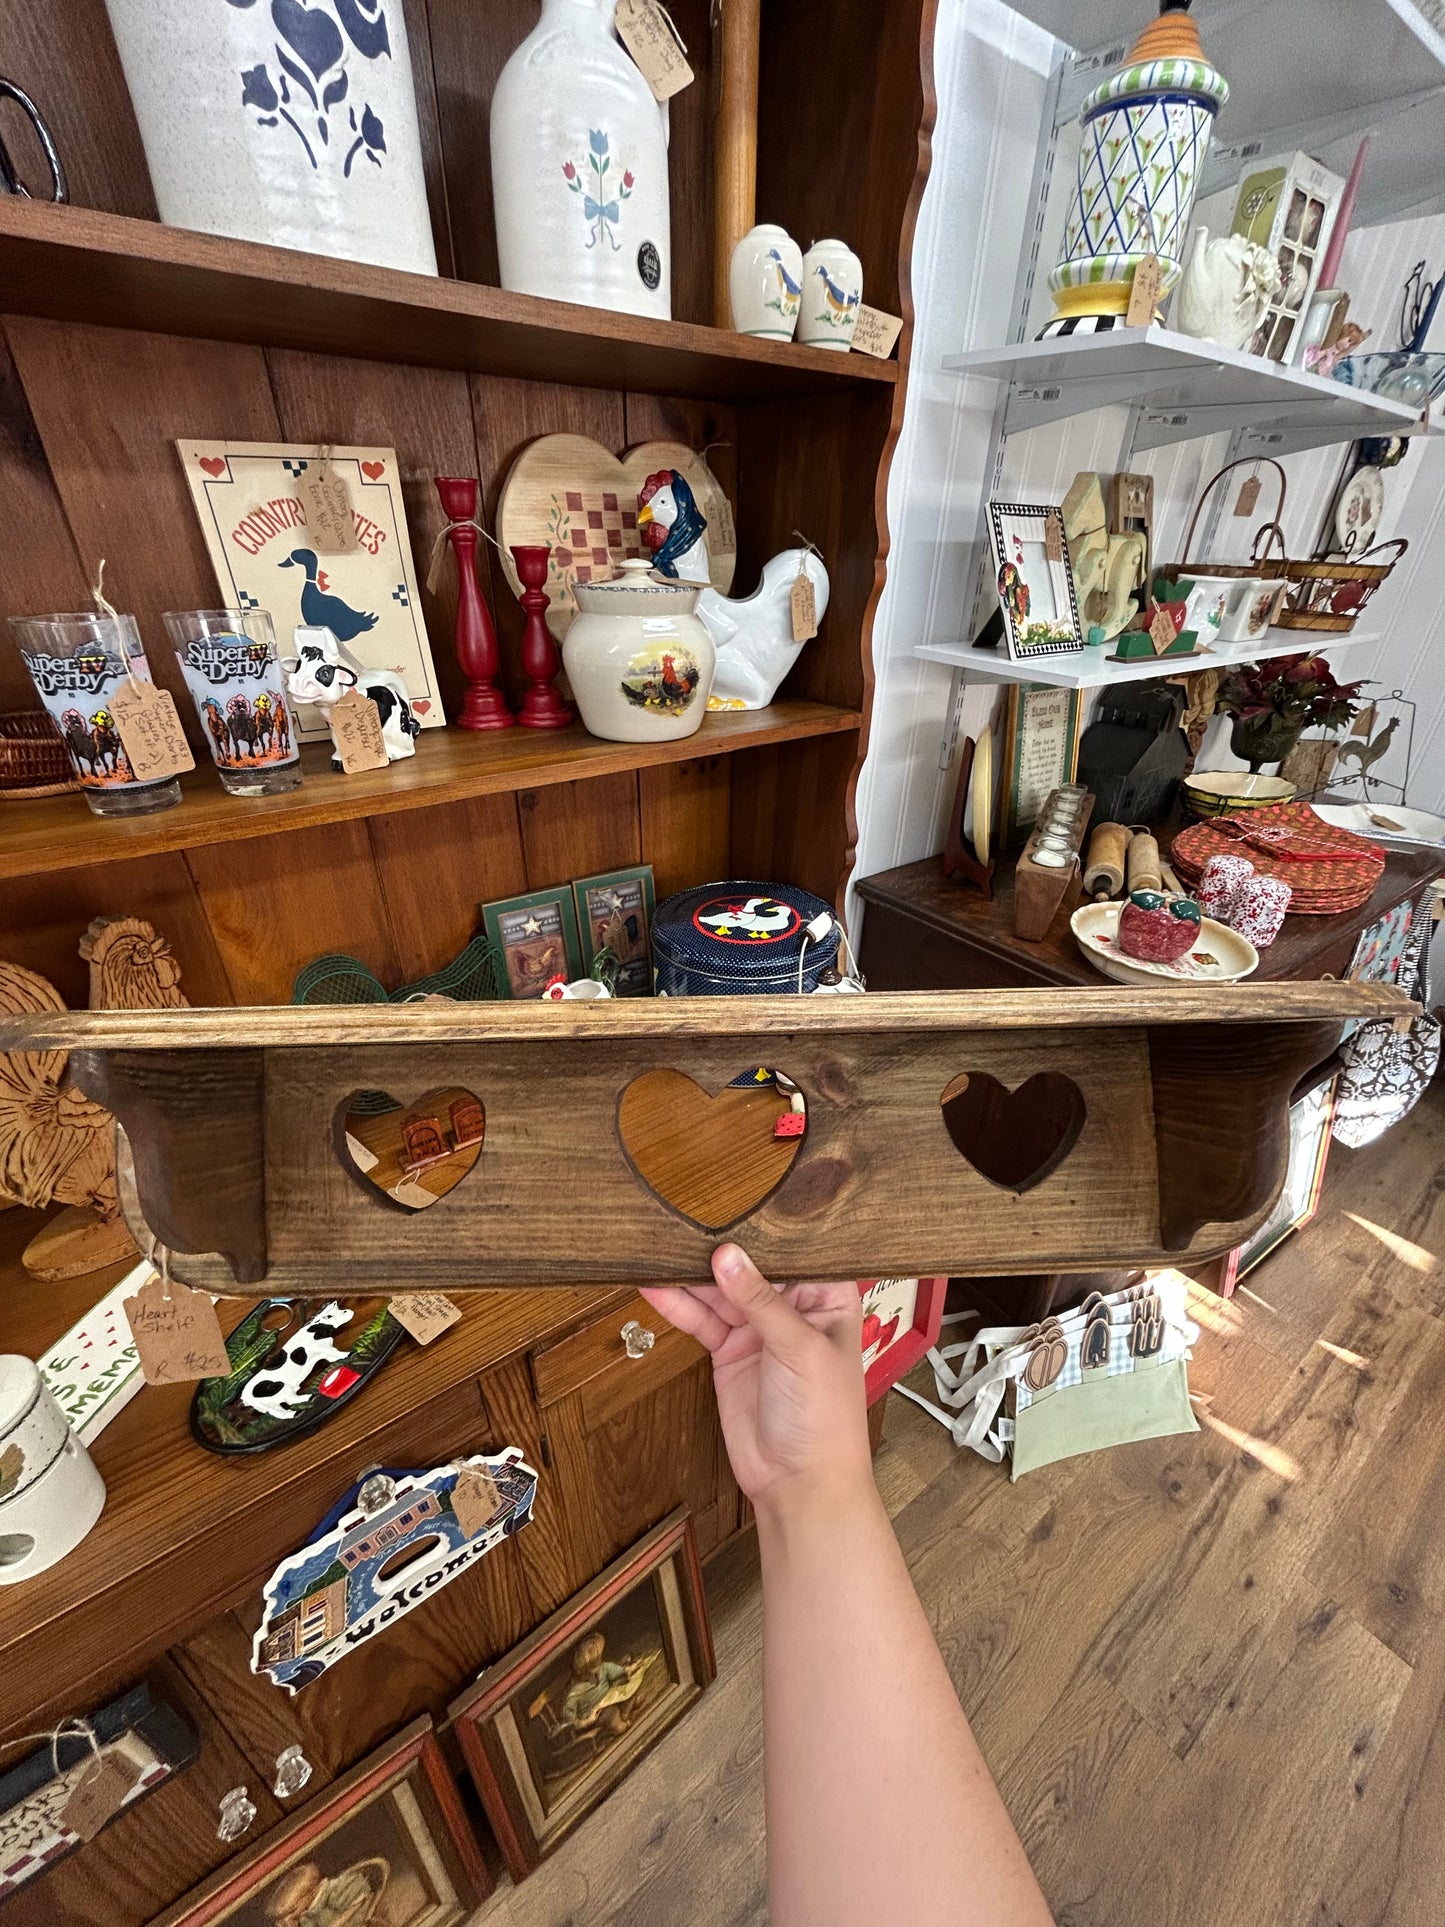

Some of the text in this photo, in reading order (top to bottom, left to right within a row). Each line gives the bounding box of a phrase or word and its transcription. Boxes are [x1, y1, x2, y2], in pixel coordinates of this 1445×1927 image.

[187, 641, 247, 666] Super
[33, 669, 114, 692] Derby
[200, 656, 272, 681] Derby
[152, 702, 167, 733] Super
[158, 693, 176, 729] Vintage
[133, 1304, 177, 1324] Heart
[139, 1316, 194, 1334] Shelf
